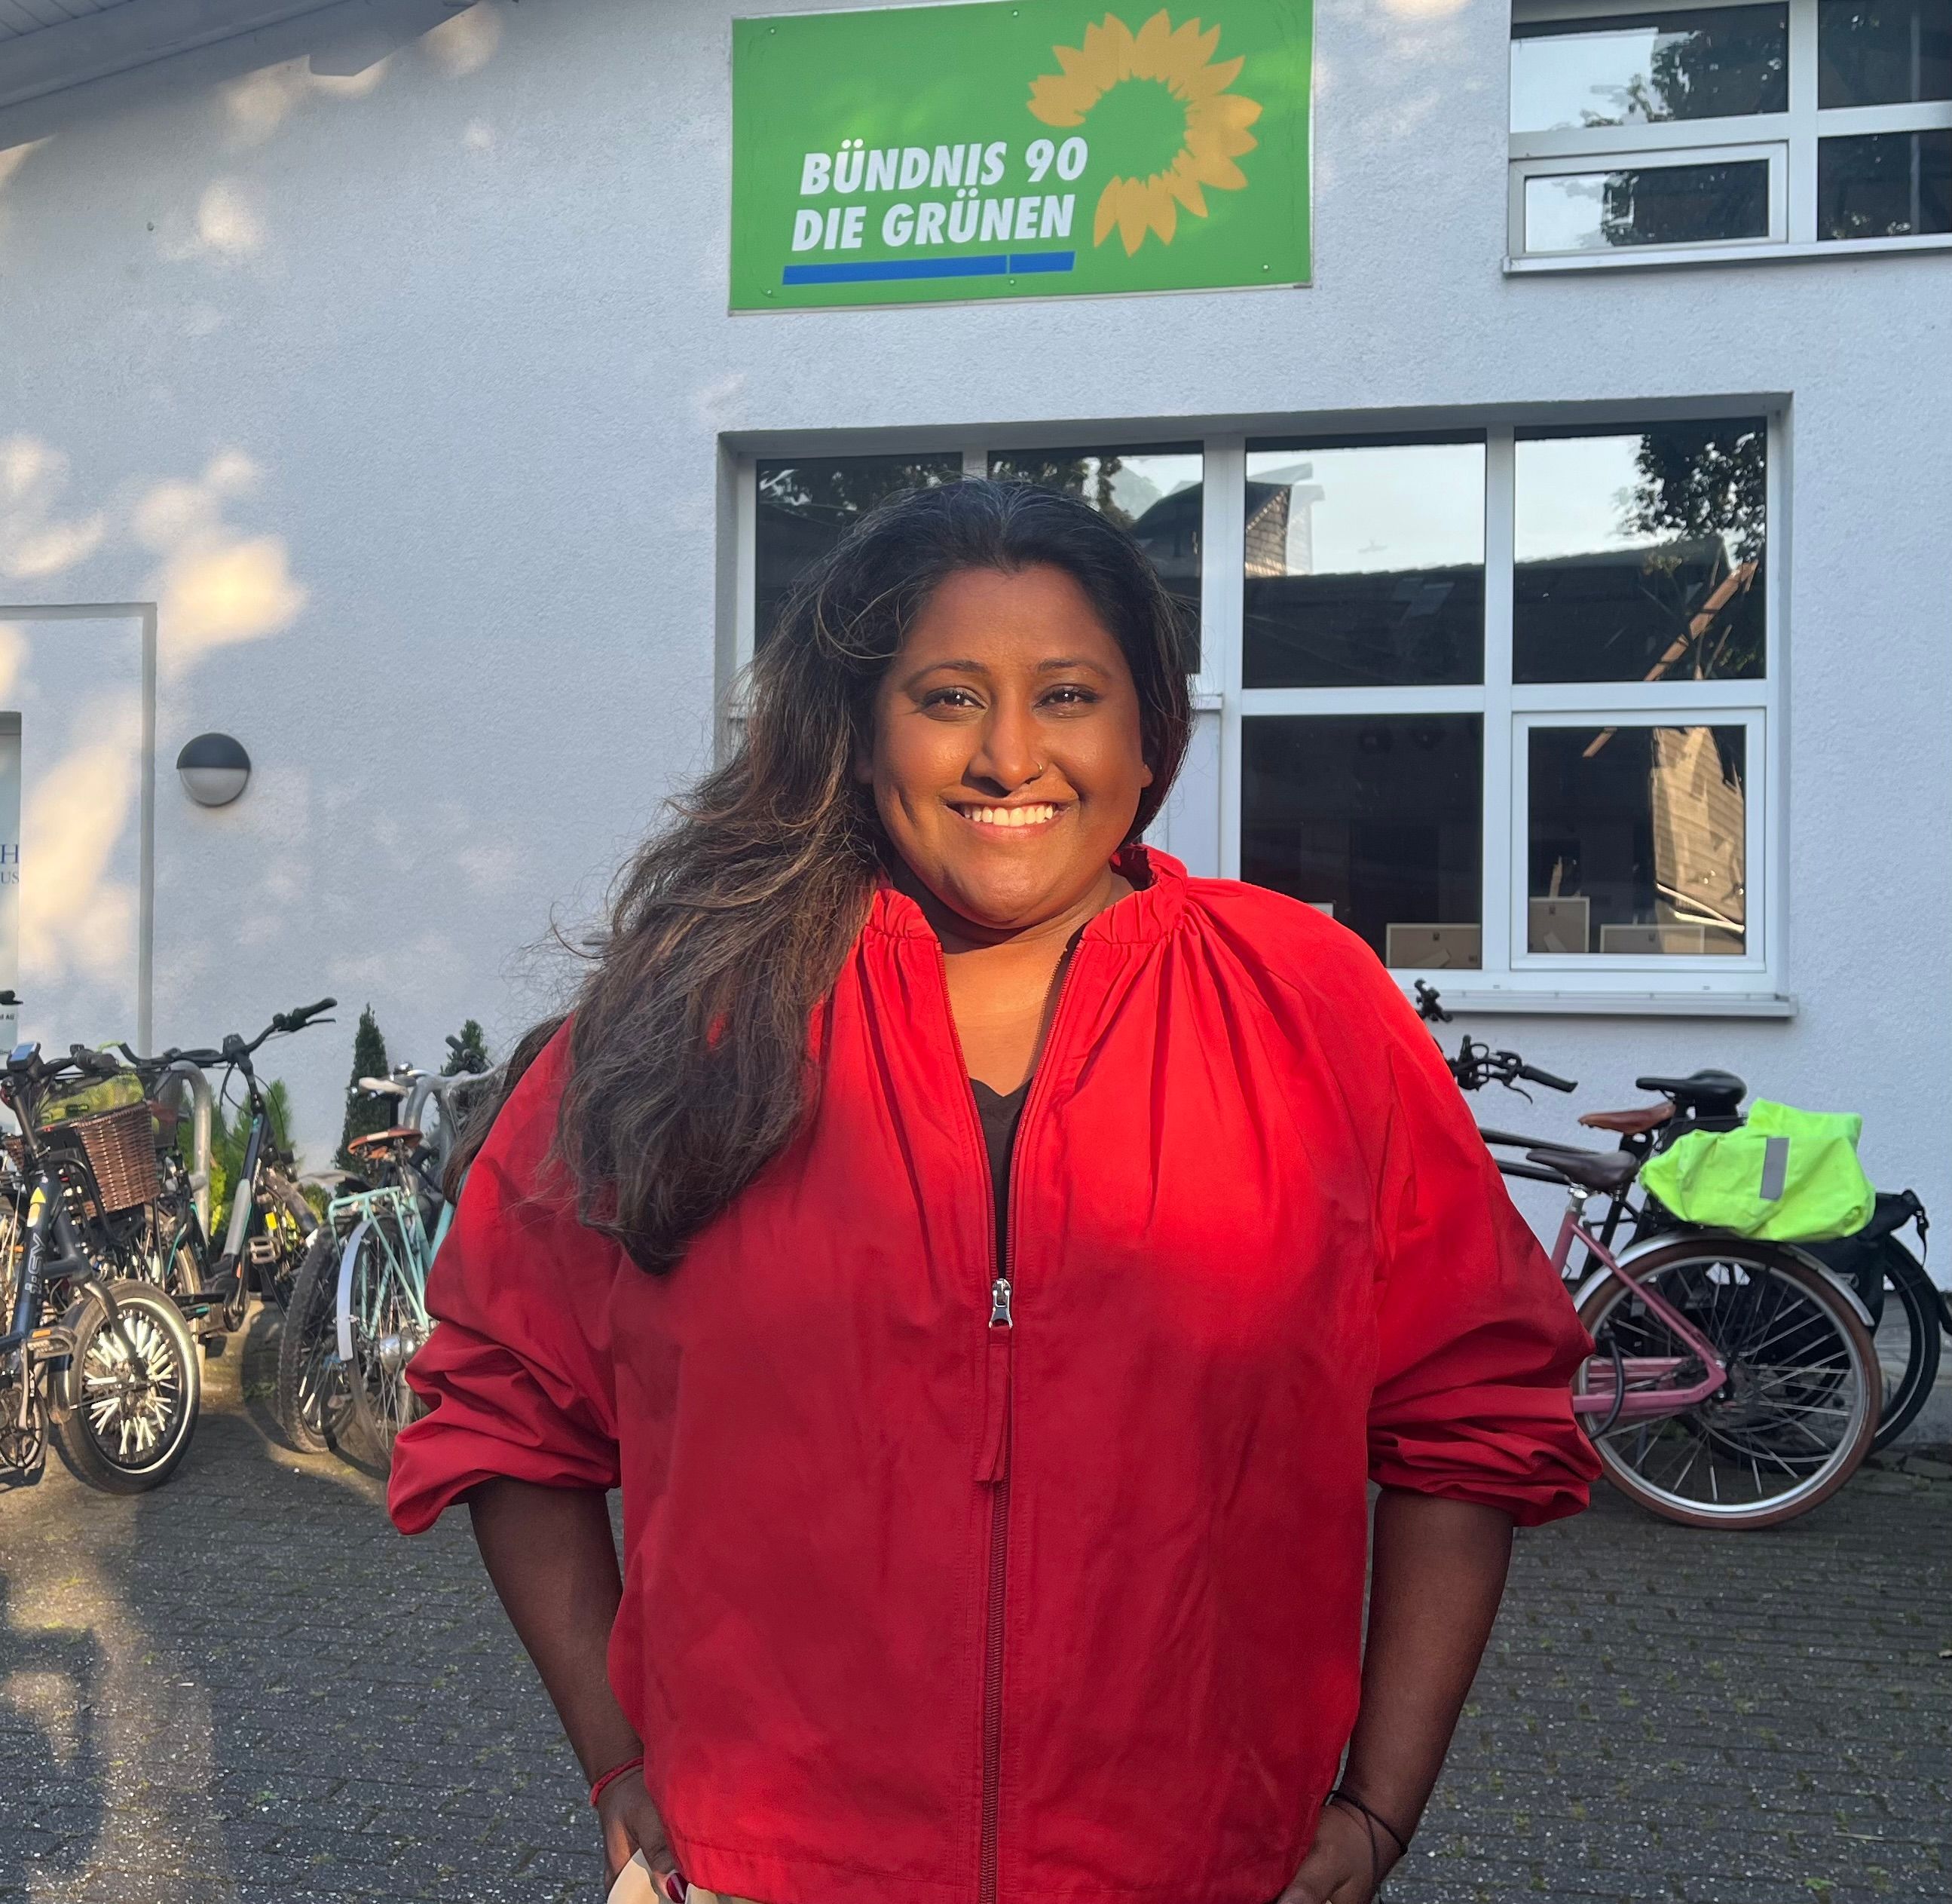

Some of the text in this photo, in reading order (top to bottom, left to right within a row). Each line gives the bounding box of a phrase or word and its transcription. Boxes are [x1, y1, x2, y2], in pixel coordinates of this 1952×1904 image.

[800, 136, 1088, 195] BÜNDNIS 90
[791, 188, 1075, 252] DIE GRÜNEN
